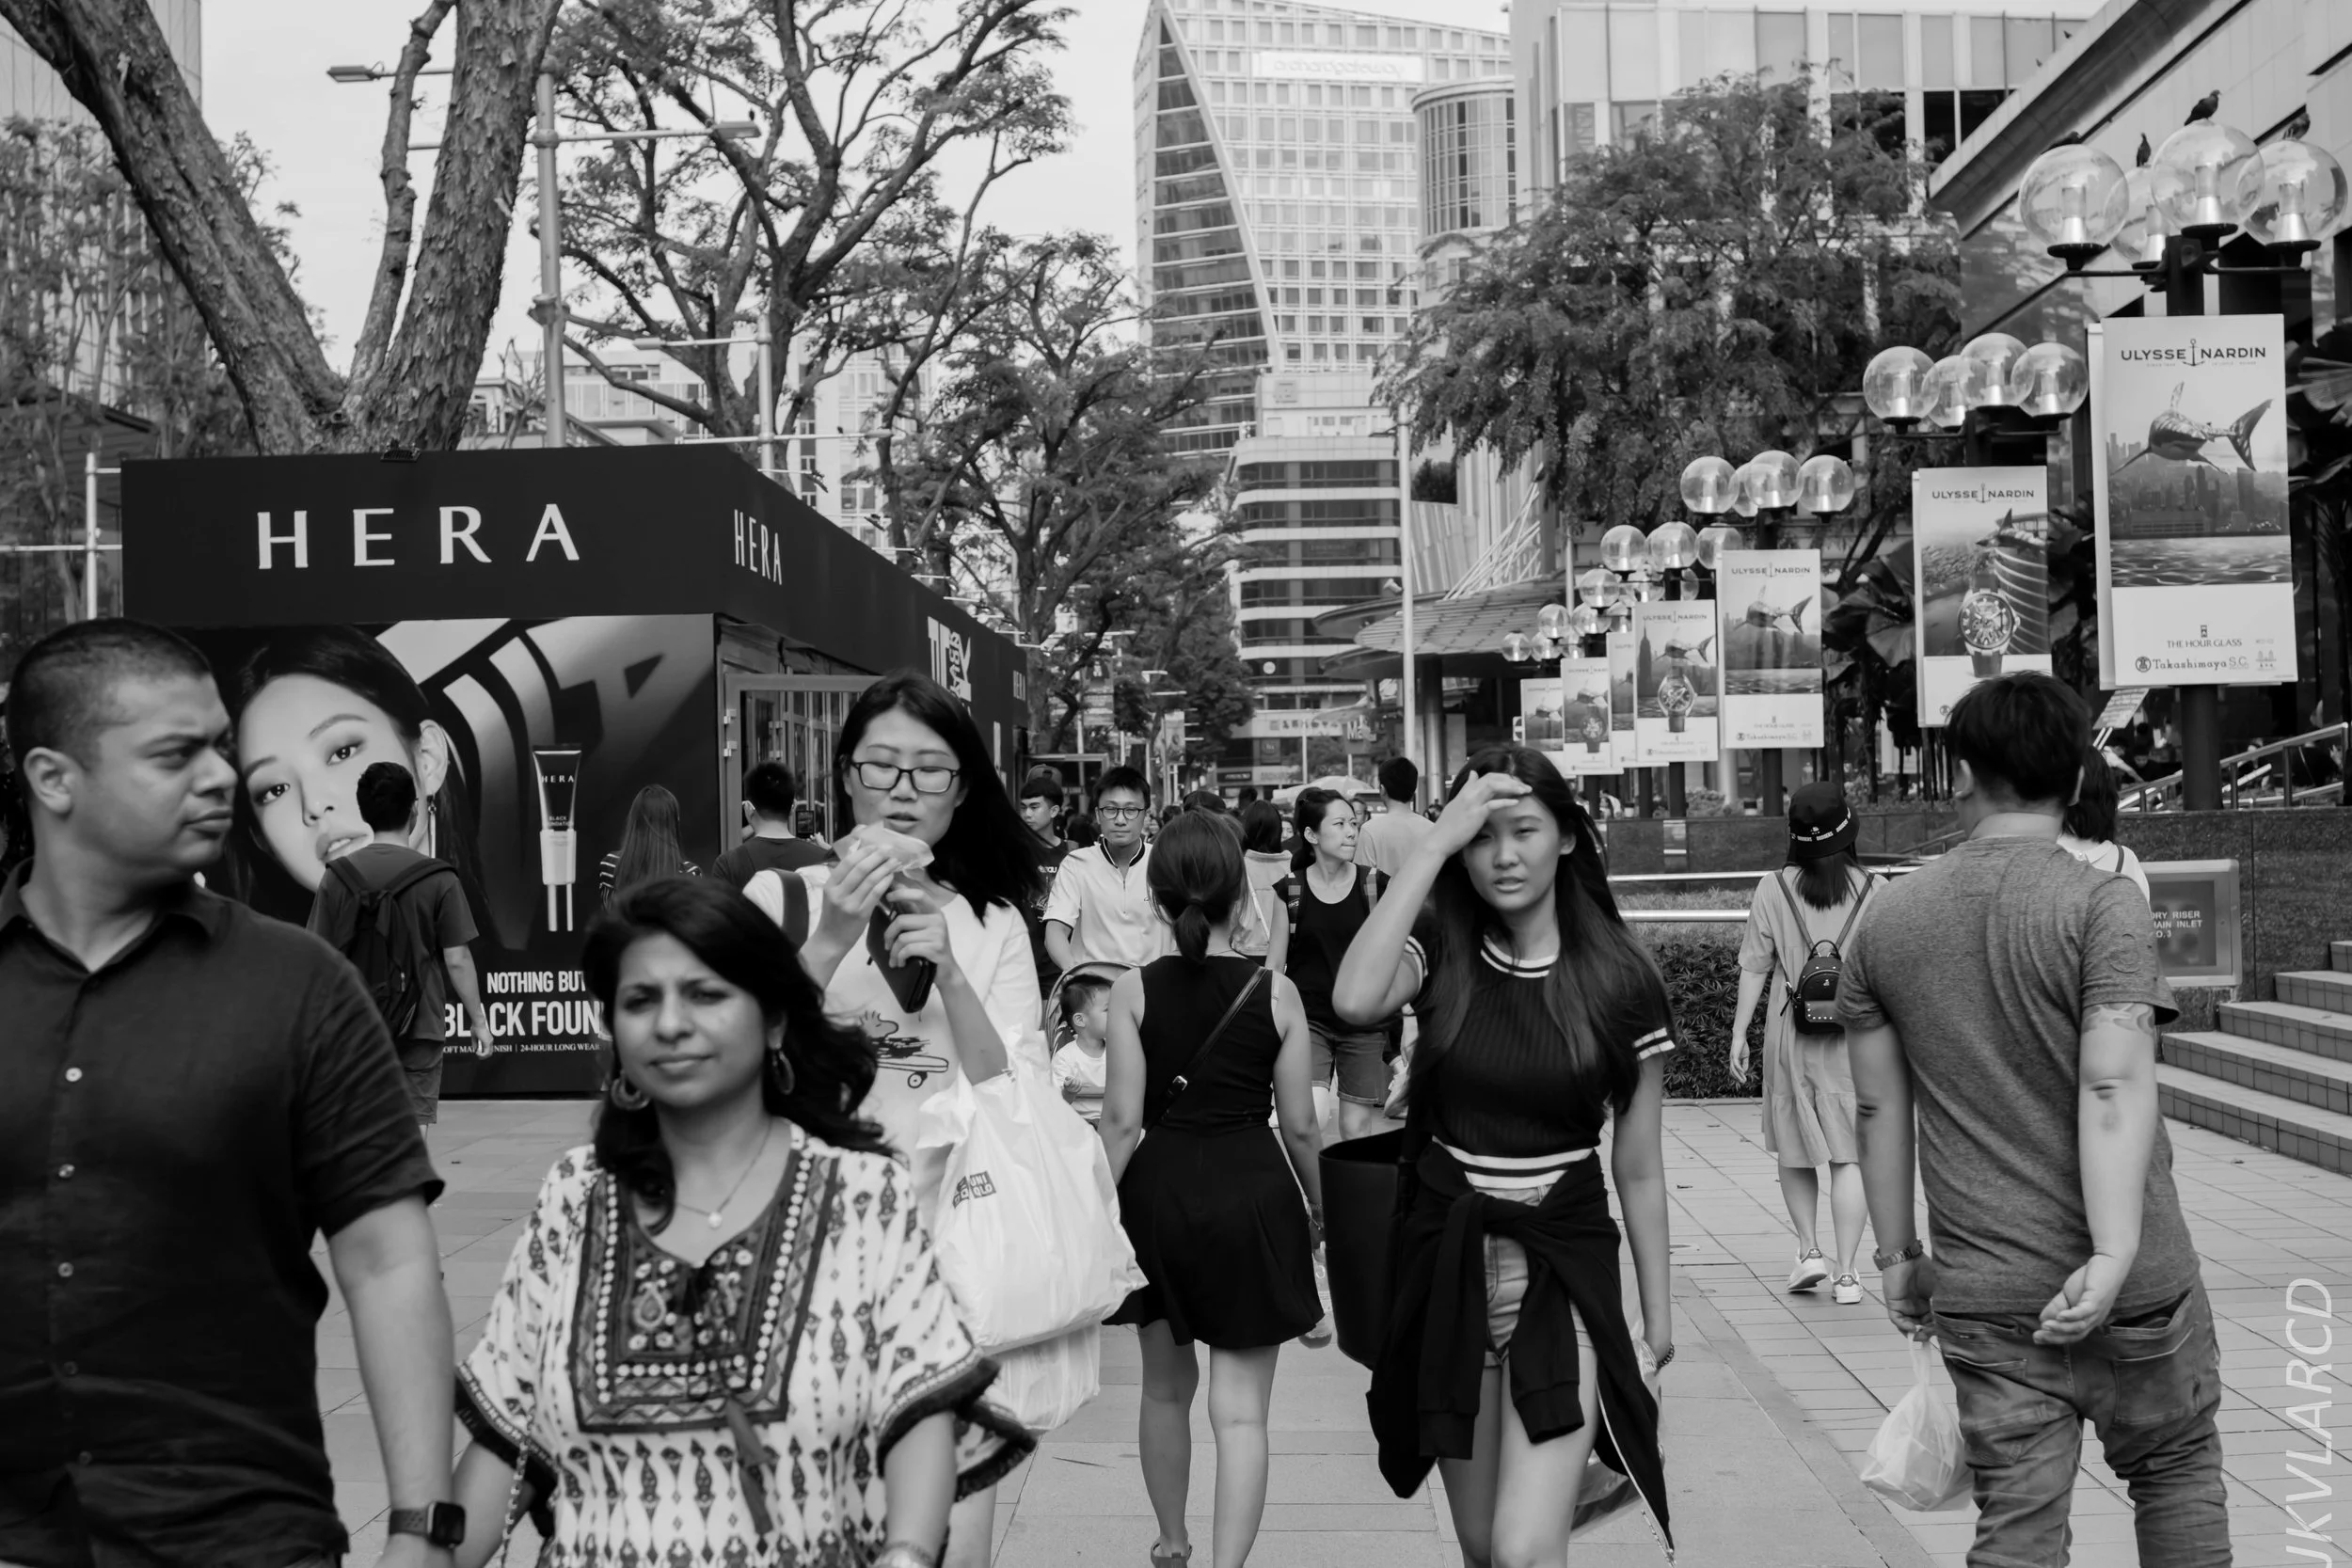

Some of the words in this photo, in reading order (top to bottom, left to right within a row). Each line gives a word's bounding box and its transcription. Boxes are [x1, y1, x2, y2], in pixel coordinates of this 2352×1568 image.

[2121, 348, 2186, 361] ULYSSE
[2201, 346, 2266, 359] NARDIN
[1931, 489, 1979, 499] ULYSSE
[1988, 489, 2034, 499] NARDIN
[257, 503, 580, 570] HERA
[733, 509, 783, 586] HERA
[2167, 640, 2184, 648] THE
[2185, 639, 2212, 648] HOUR
[2213, 638, 2243, 647] GLASS
[2153, 657, 2227, 671] Takashimaya
[542, 774, 575, 784] HERA
[2172, 910, 2201, 919] RISER
[2176, 919, 2202, 928] INLET
[486, 971, 554, 993] NOTHING
[558, 970, 586, 992] BUT
[532, 1000, 604, 1036] FOUN
[442, 1045, 459, 1053] OFT
[520, 1043, 553, 1053] 24-HOUR
[554, 1043, 576, 1052] LONG
[577, 1042, 600, 1052] WEAR
[970, 1174, 988, 1187] UNI
[973, 1183, 993, 1196] QLO
